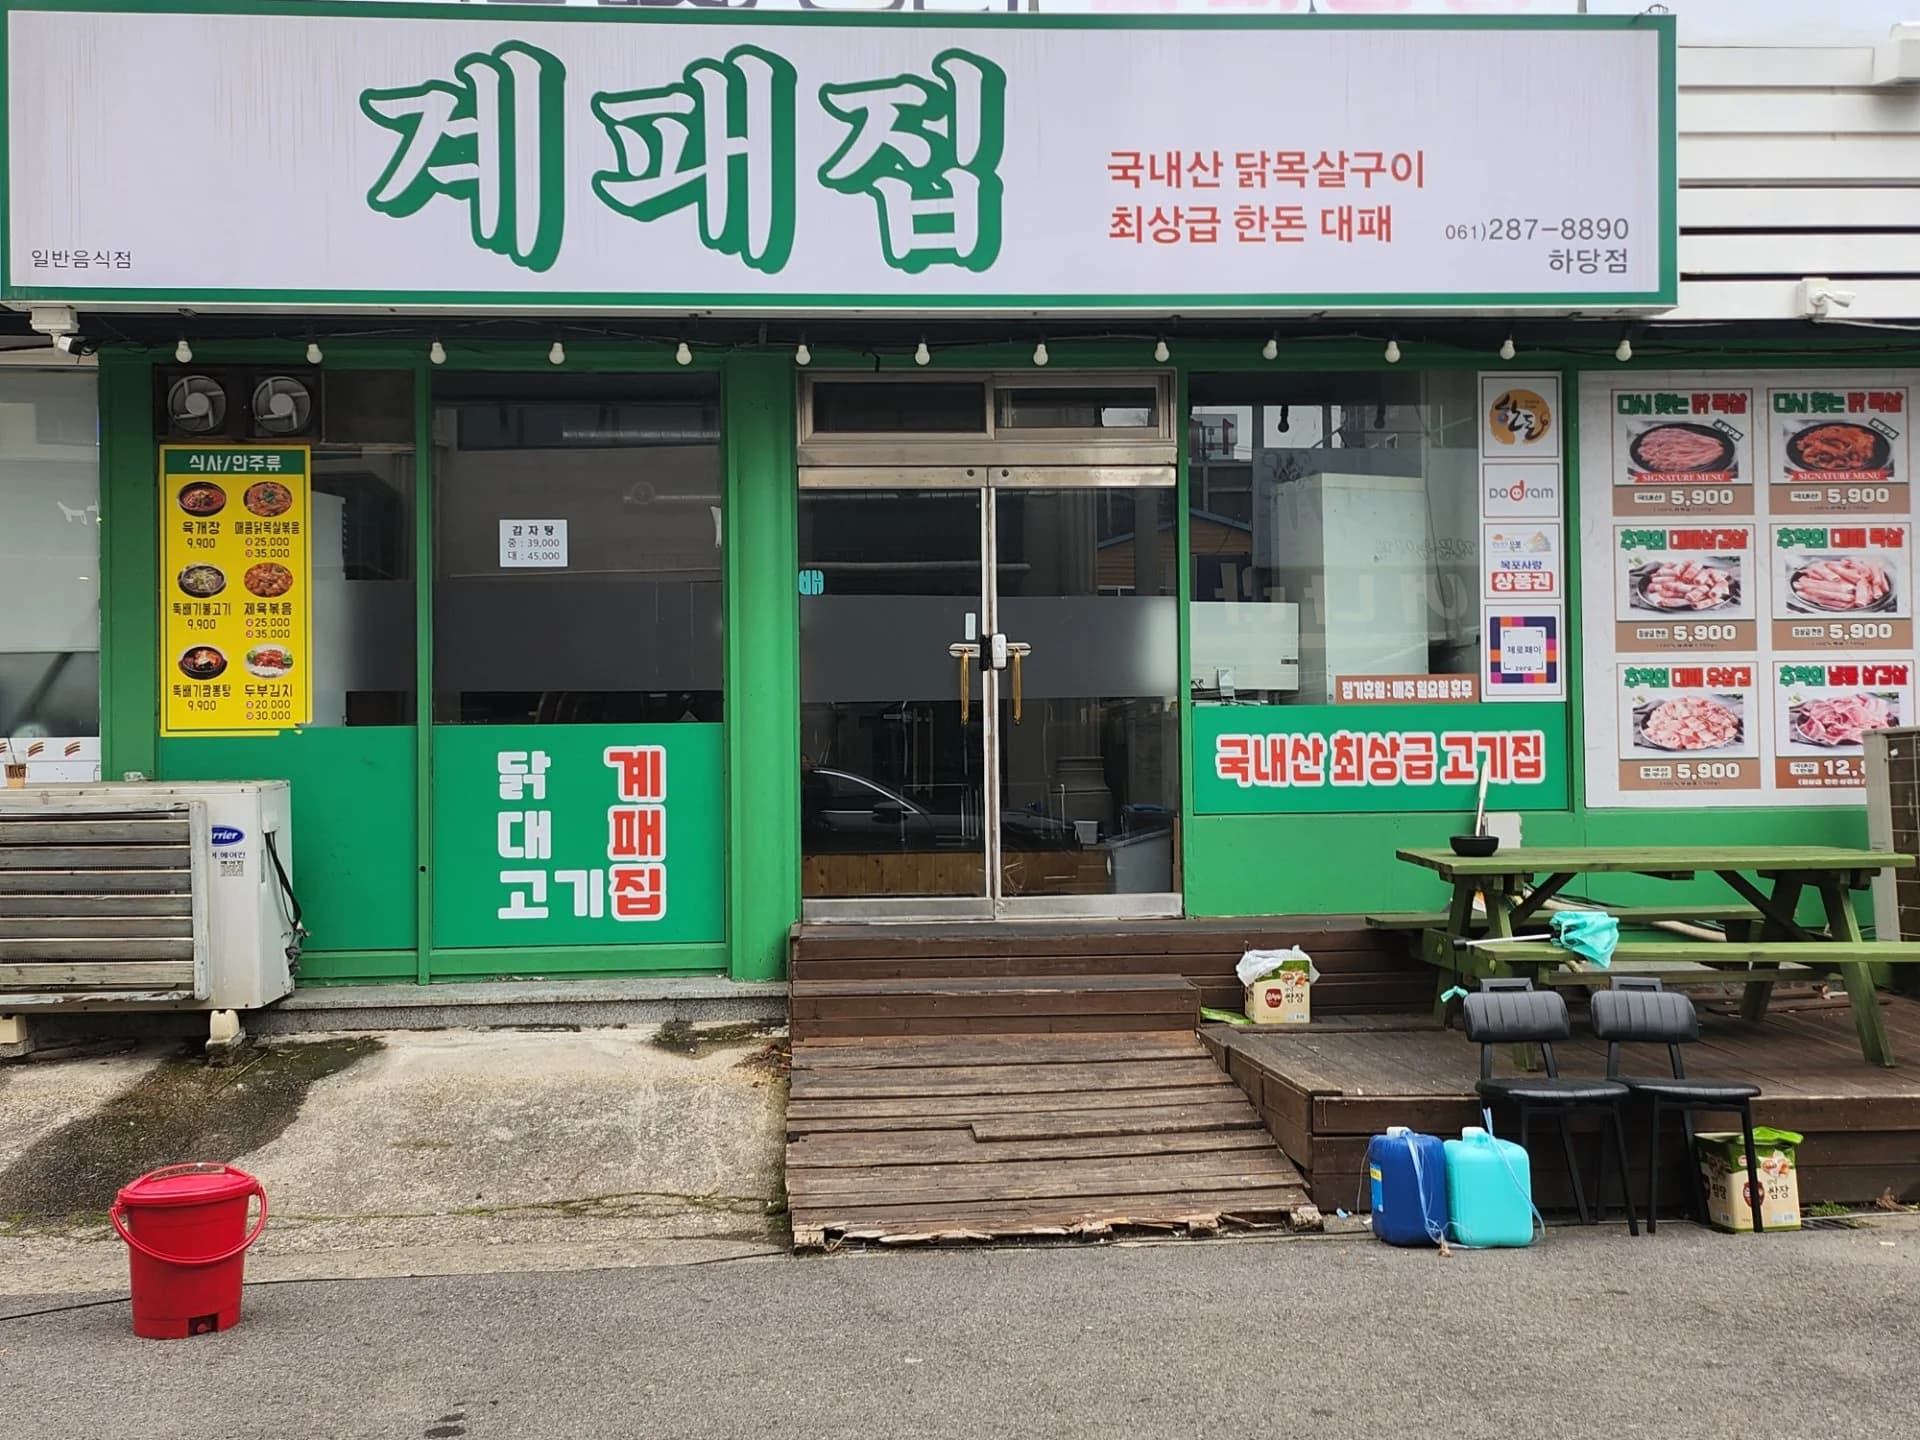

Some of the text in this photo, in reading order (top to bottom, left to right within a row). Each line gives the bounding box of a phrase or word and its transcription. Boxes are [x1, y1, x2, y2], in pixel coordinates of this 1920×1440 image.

[360, 40, 1006, 274] 계패집
[1106, 150, 1427, 190] 국내산 닭목살구이
[1109, 205, 1394, 244] 최상급 한돈 대패
[1444, 218, 1630, 241] 061)287-8890
[30, 248, 133, 270] 일반음식점
[1548, 248, 1629, 275] 하당점
[189, 455, 282, 472] 식사/안주류
[1643, 472, 1726, 482] SIGNATURE MENU
[1799, 471, 1881, 481] SIGNATURE MENU
[1671, 489, 1733, 506] 5,900
[1827, 488, 1889, 505] 5,900
[182, 521, 220, 535] 육개장
[527, 538, 560, 549] 39,000
[1870, 528, 1904, 548] 목살
[507, 551, 517, 561] 대
[527, 551, 560, 562] 45,000
[1495, 573, 1550, 590] 상품권
[173, 602, 231, 616] 뚝배기불고기
[244, 602, 292, 616] 제육볶음
[1674, 625, 1737, 641] 5,900
[1829, 623, 1892, 640] 5,900
[1507, 645, 1541, 655] 제로페이
[173, 684, 231, 698] 뚝배기짬뽕탕
[244, 684, 293, 698] 두부김치
[1451, 680, 1472, 699] 휴무
[1216, 730, 1545, 788] 국내산 최상급 고기집
[498, 750, 551, 800] 닭
[1676, 762, 1740, 780] 5,900
[498, 810, 551, 859] 대
